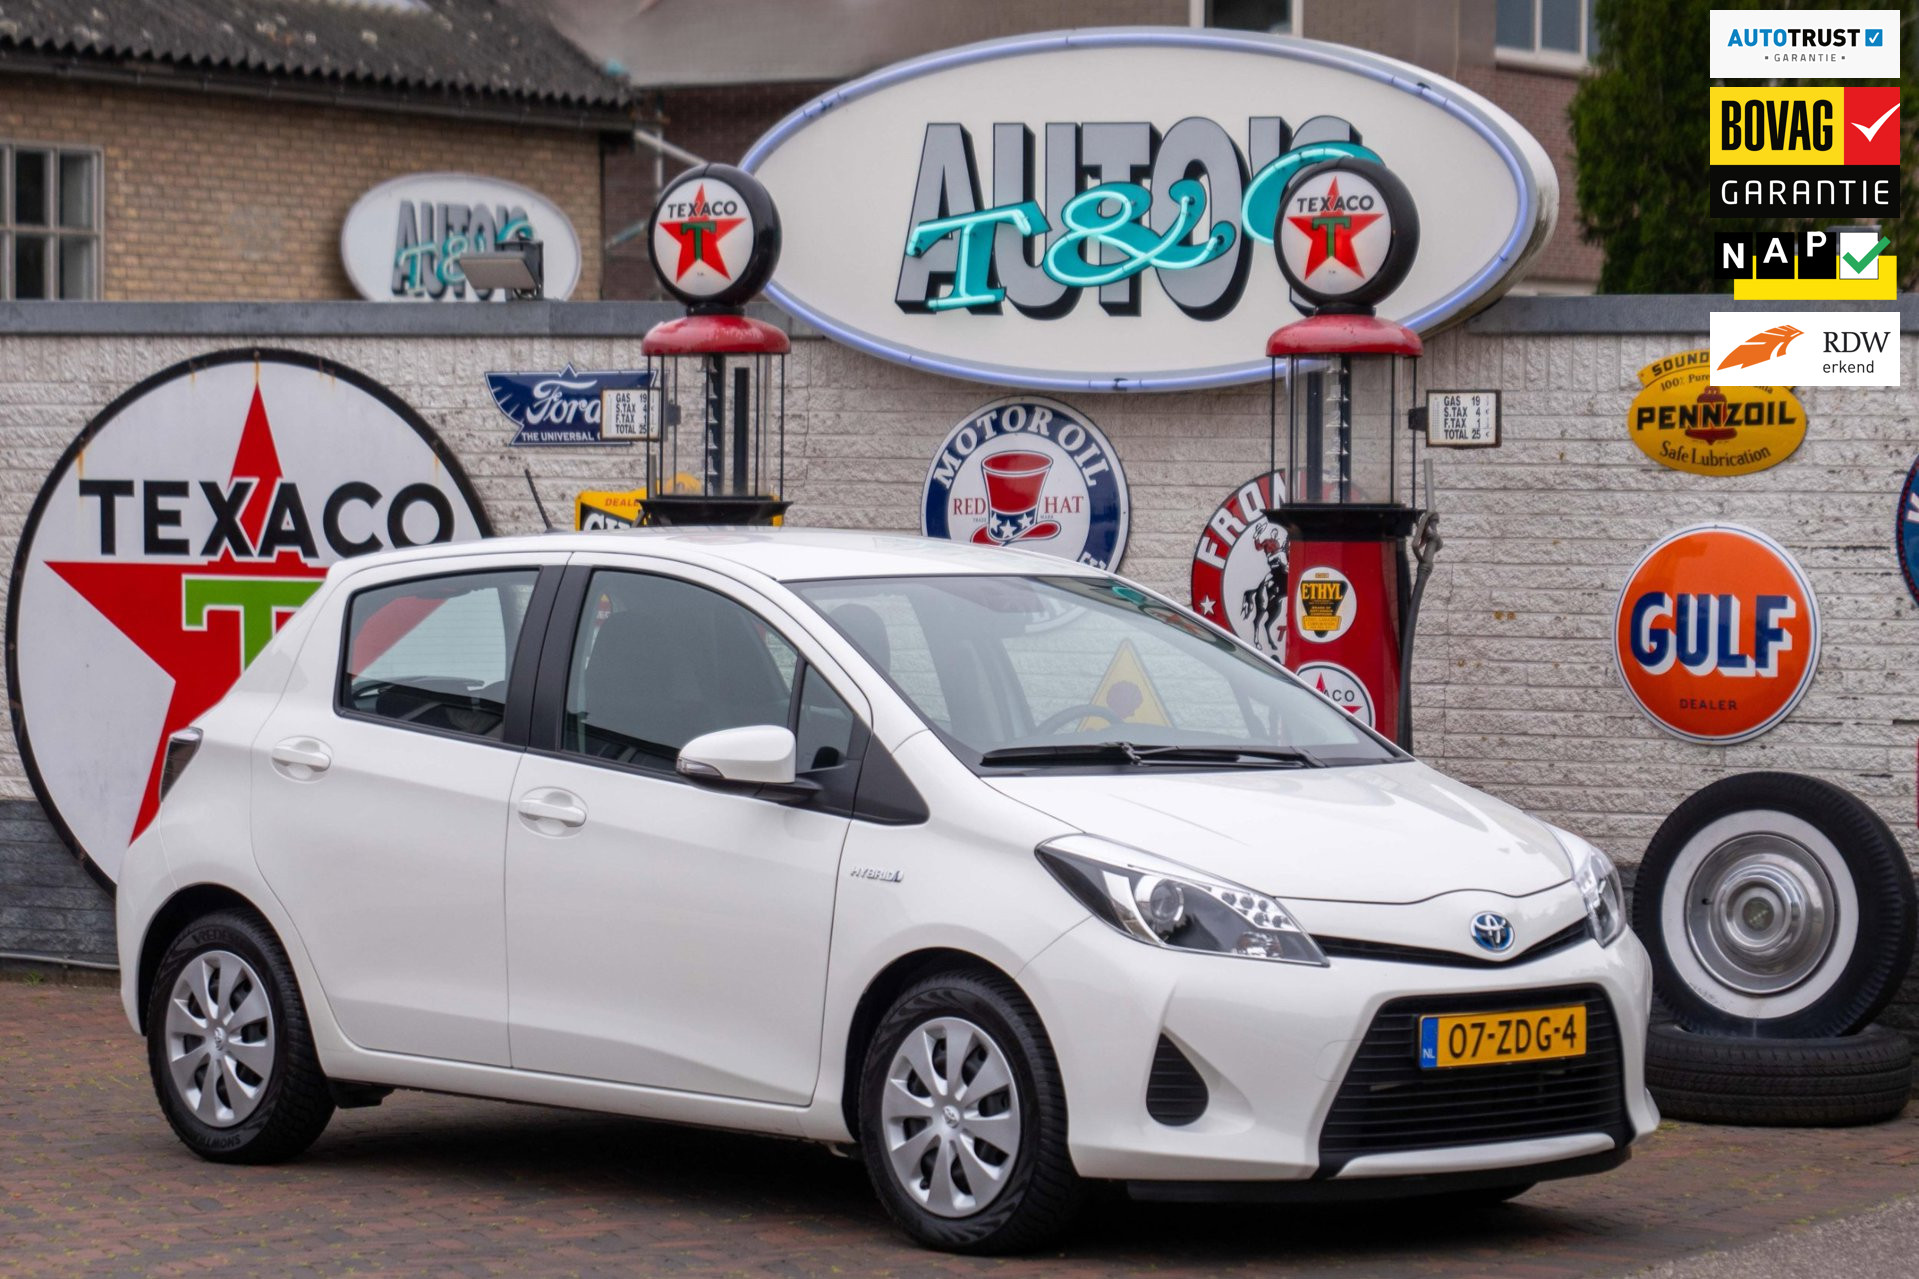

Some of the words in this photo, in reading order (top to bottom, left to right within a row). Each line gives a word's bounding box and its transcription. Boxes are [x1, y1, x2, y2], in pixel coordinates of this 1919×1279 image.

[668, 201, 737, 218] TEXACO
[1297, 195, 1375, 212] TEXACO
[680, 220, 717, 262] T
[1312, 216, 1352, 259] T
[616, 393, 631, 403] GAS
[1444, 396, 1461, 407] GAS
[1472, 396, 1481, 407] 19
[616, 403, 636, 413] S.TAX
[1444, 407, 1468, 418] S.TAX
[1476, 407, 1481, 417] 4
[1637, 401, 1797, 431] PENNZOIL
[616, 413, 635, 424] F.TAX
[1444, 418, 1467, 429] F.TAX
[522, 432, 540, 441] THE
[541, 432, 594, 441] UNIVERSAL
[616, 424, 636, 434] TOTAL
[1444, 429, 1468, 440] TOTAL
[1472, 429, 1481, 440] 25
[933, 406, 1053, 490] MOTOR
[1058, 424, 1110, 487] OIL
[1660, 440, 1689, 463] Safe
[1692, 446, 1771, 467] Lubrication
[953, 498, 986, 516] RED
[1044, 496, 1083, 514] HAT
[79, 480, 455, 559] TEXACO
[1301, 583, 1344, 600] ETHYL
[1630, 591, 1796, 678] GULF
[1679, 699, 1738, 711] DEALER
[1450, 1014, 1576, 1059] 07-ZDG-4
[1422, 1048, 1435, 1059] NL
